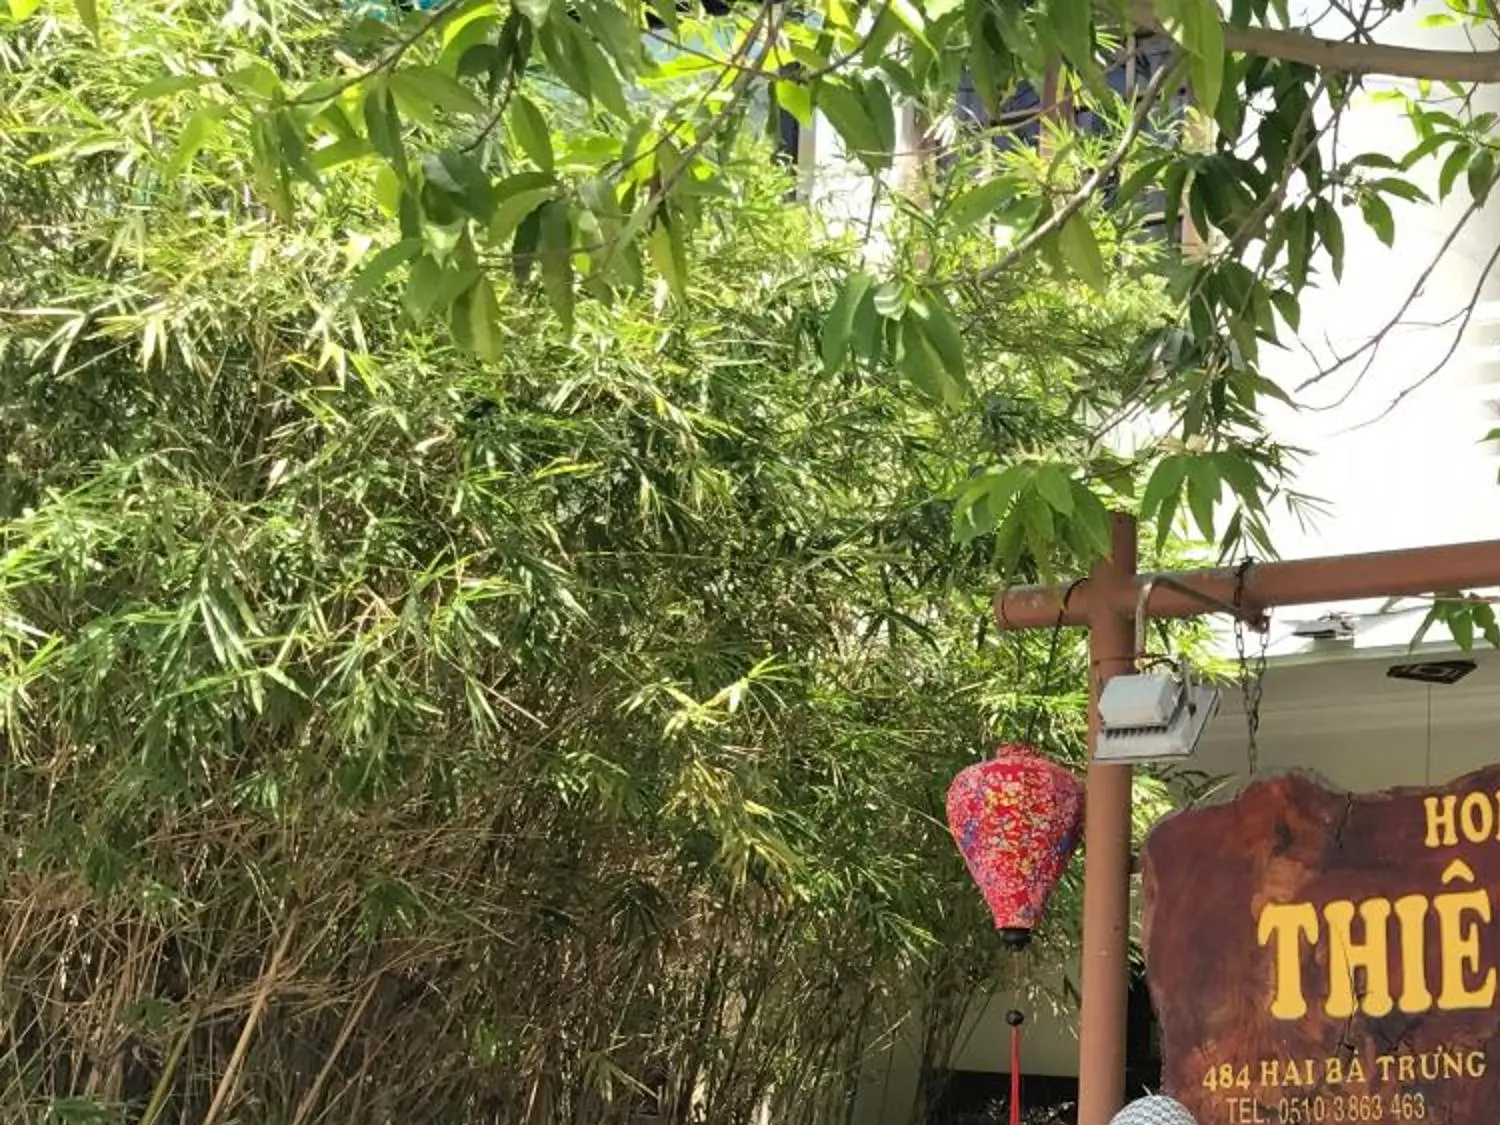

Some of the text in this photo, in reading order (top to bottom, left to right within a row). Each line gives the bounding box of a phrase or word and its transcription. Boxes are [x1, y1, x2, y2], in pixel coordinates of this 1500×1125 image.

[1202, 1062, 1251, 1092] 484
[1260, 1058, 1316, 1087] HAI
[1390, 1091, 1426, 1121] 463
